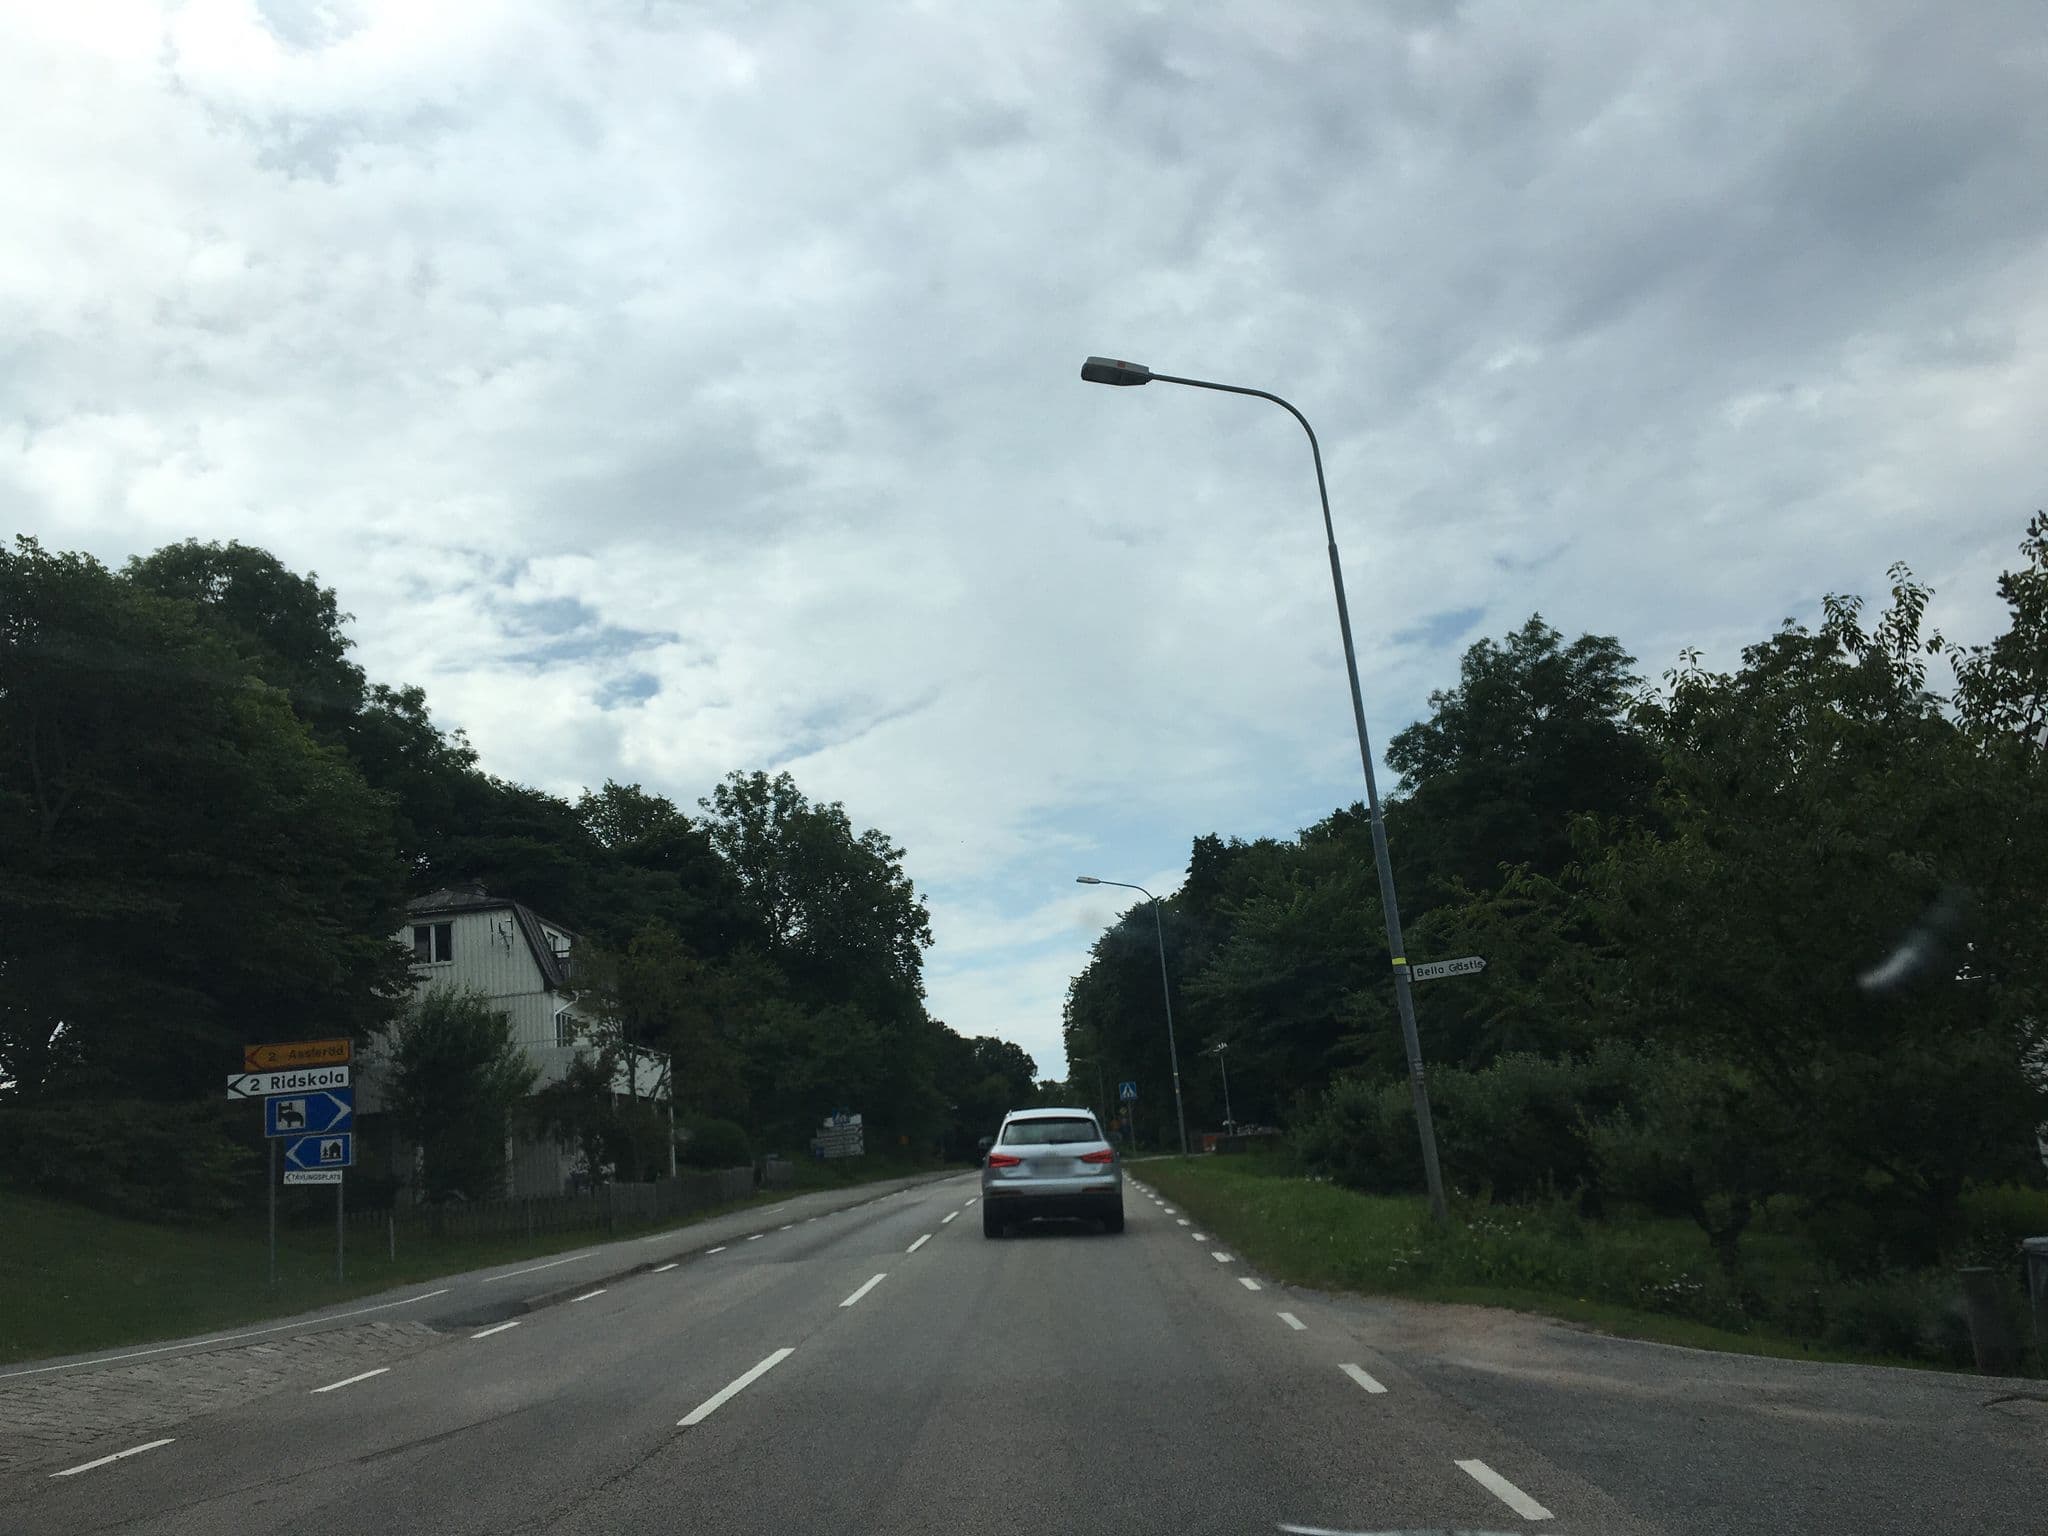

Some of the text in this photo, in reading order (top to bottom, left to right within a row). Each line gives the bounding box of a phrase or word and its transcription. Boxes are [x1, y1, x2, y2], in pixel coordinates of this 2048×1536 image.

[1416, 965, 1444, 977] Bella
[250, 1070, 344, 1091] 2 Ridskola
